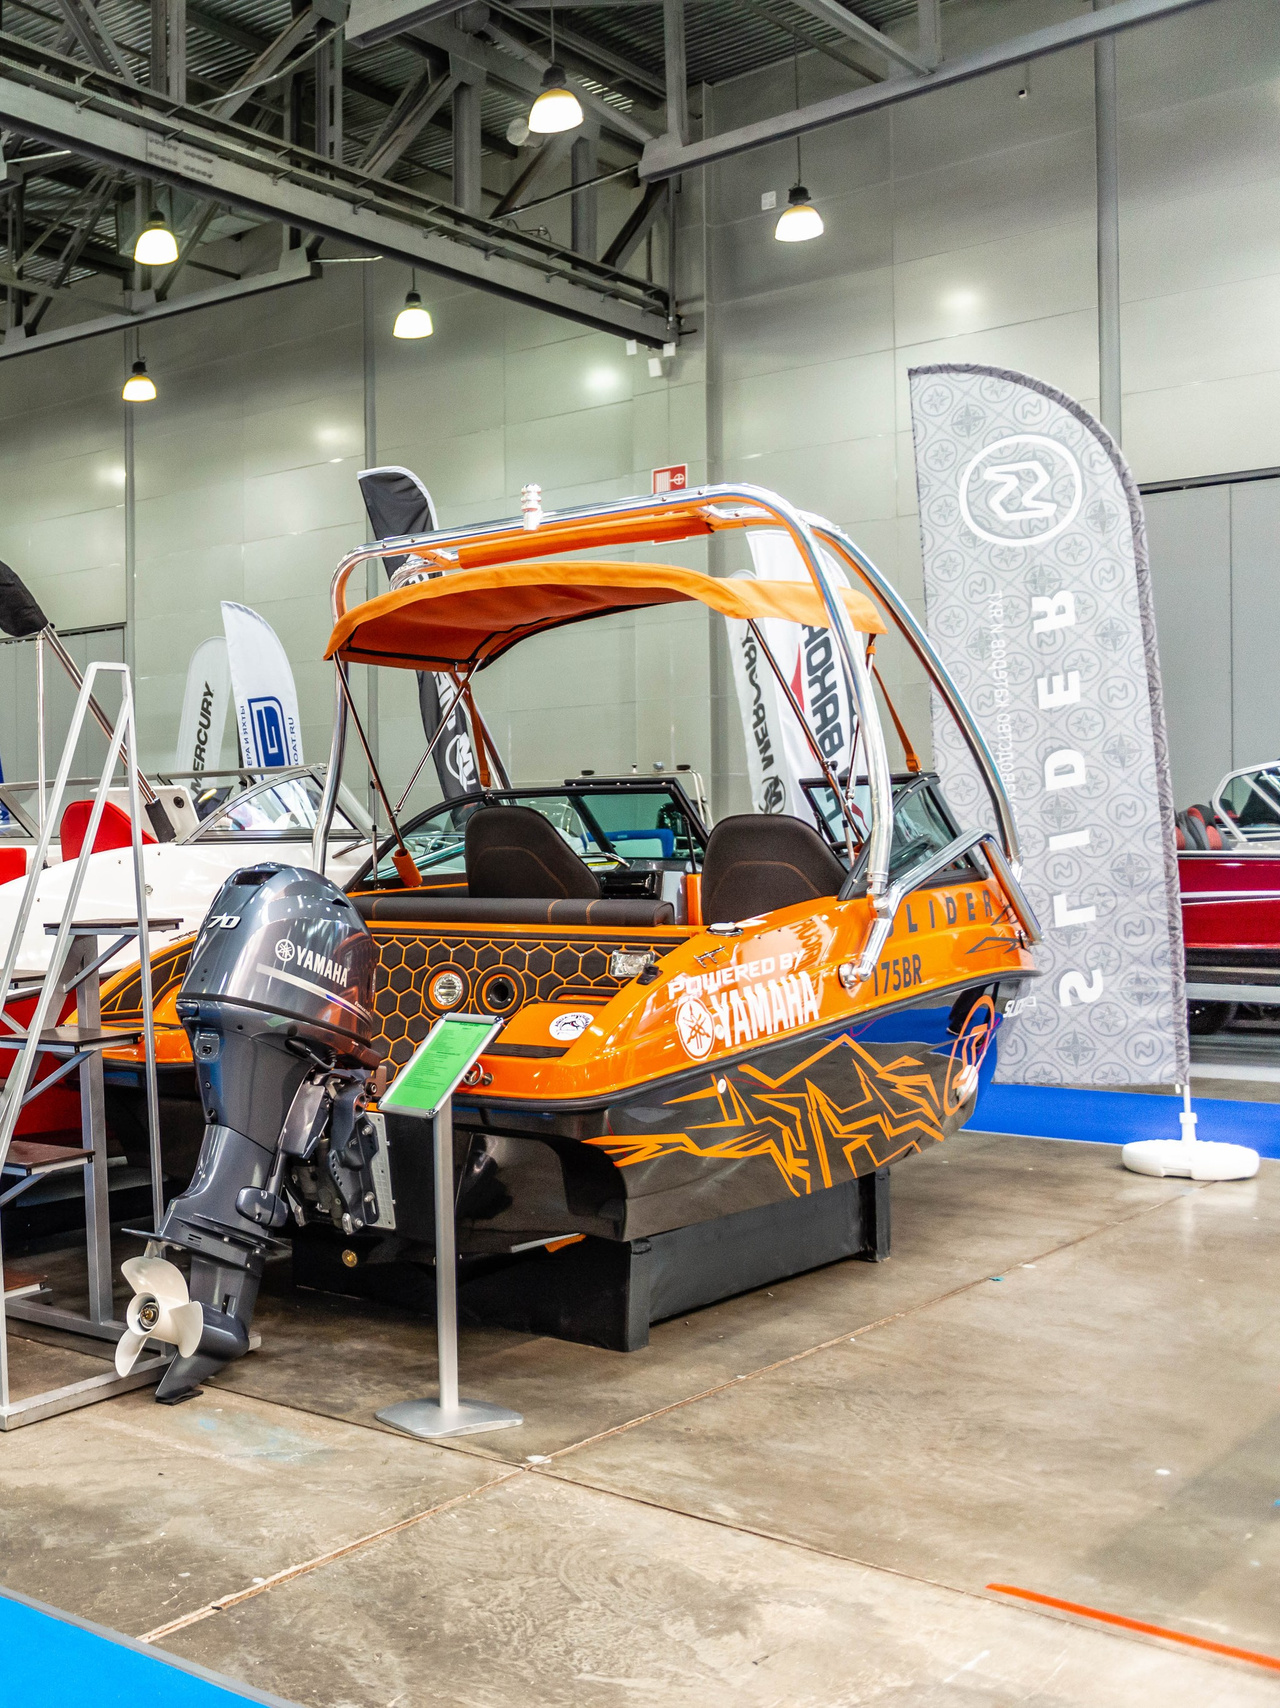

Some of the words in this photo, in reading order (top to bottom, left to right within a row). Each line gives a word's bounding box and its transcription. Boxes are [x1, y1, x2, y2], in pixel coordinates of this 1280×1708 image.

[240, 705, 248, 735] ЯХТЫ
[207, 914, 241, 930] 70
[296, 945, 349, 988] YAMAHA
[668, 957, 776, 1000] POWERED
[779, 950, 806, 974] BY
[710, 970, 820, 1048] YAMAHA
